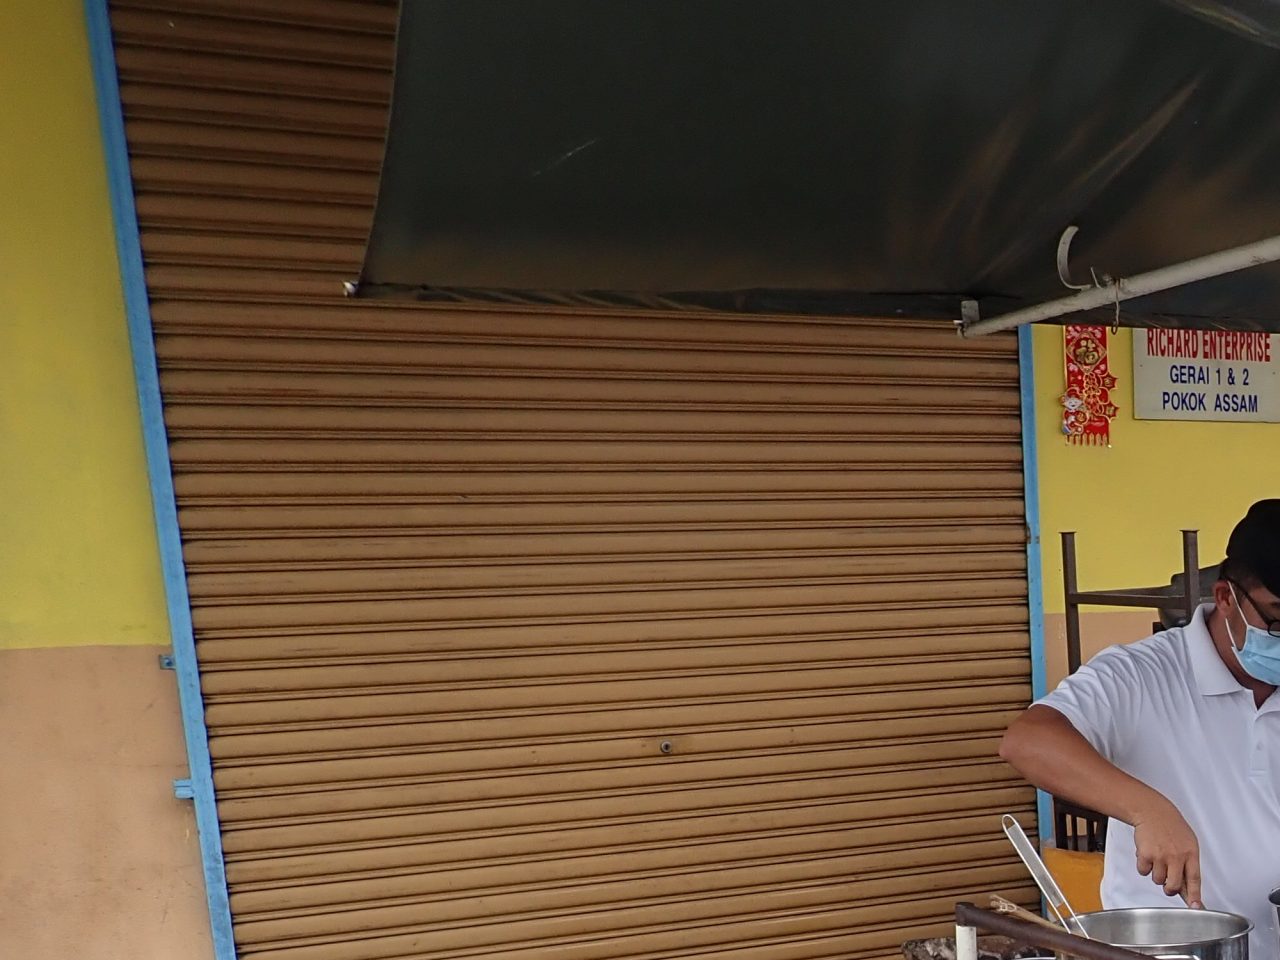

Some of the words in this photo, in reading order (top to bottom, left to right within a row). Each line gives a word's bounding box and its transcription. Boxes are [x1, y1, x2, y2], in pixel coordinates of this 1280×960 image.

[1146, 328, 1199, 359] RICHARD
[1202, 331, 1271, 362] ENTERPRISE
[1169, 365, 1210, 386] GERAI
[1215, 368, 1222, 385] 1
[1227, 368, 1236, 385] &
[1242, 368, 1250, 386] 2
[1162, 392, 1207, 412] POKOK
[1214, 393, 1258, 413] ASSAM
